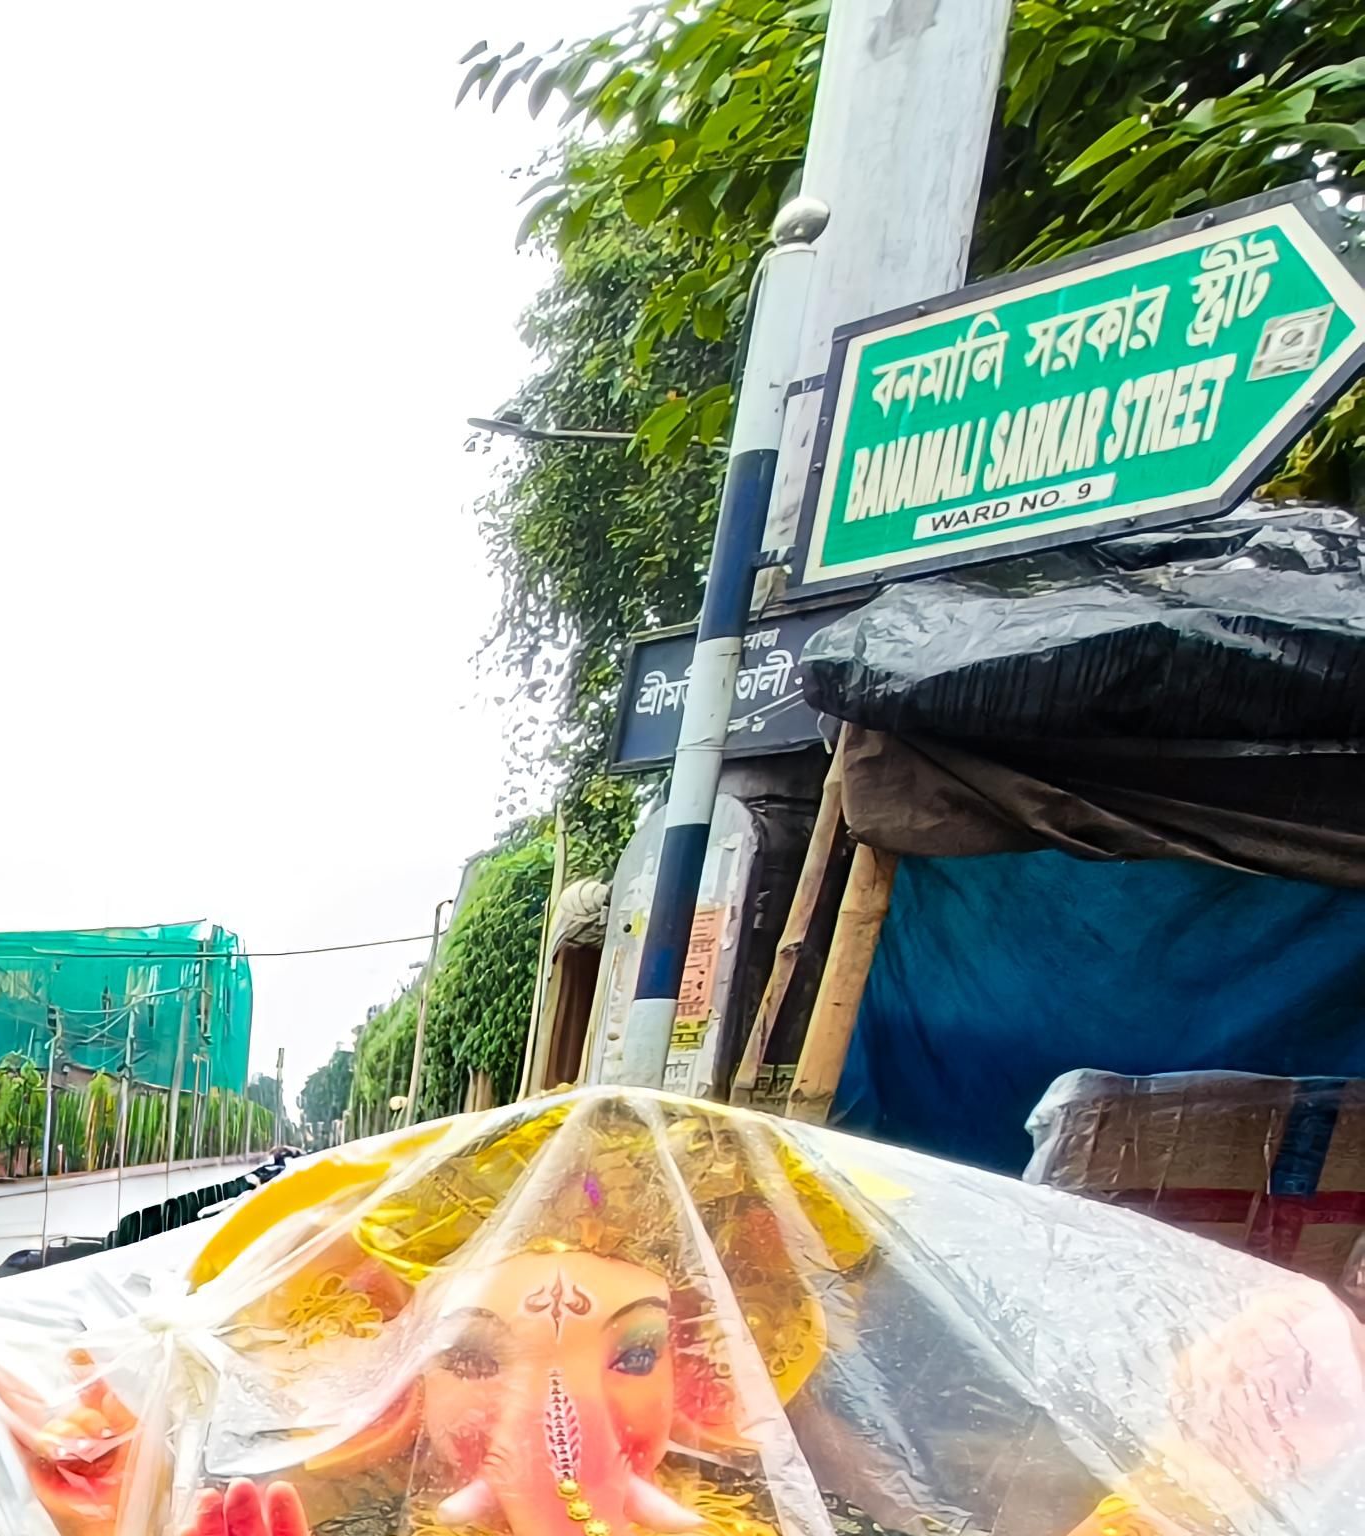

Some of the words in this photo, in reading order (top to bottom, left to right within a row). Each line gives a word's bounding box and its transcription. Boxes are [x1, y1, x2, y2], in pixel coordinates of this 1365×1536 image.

[871, 311, 1010, 418] বনমালি
[1024, 283, 1171, 378] সরকার
[844, 417, 988, 523] BANAMALI
[983, 386, 1107, 492] SARKAR
[1105, 354, 1236, 466] STREET
[931, 501, 1011, 532] WARD
[1019, 487, 1066, 514] NO.
[1077, 482, 1093, 500] 9
